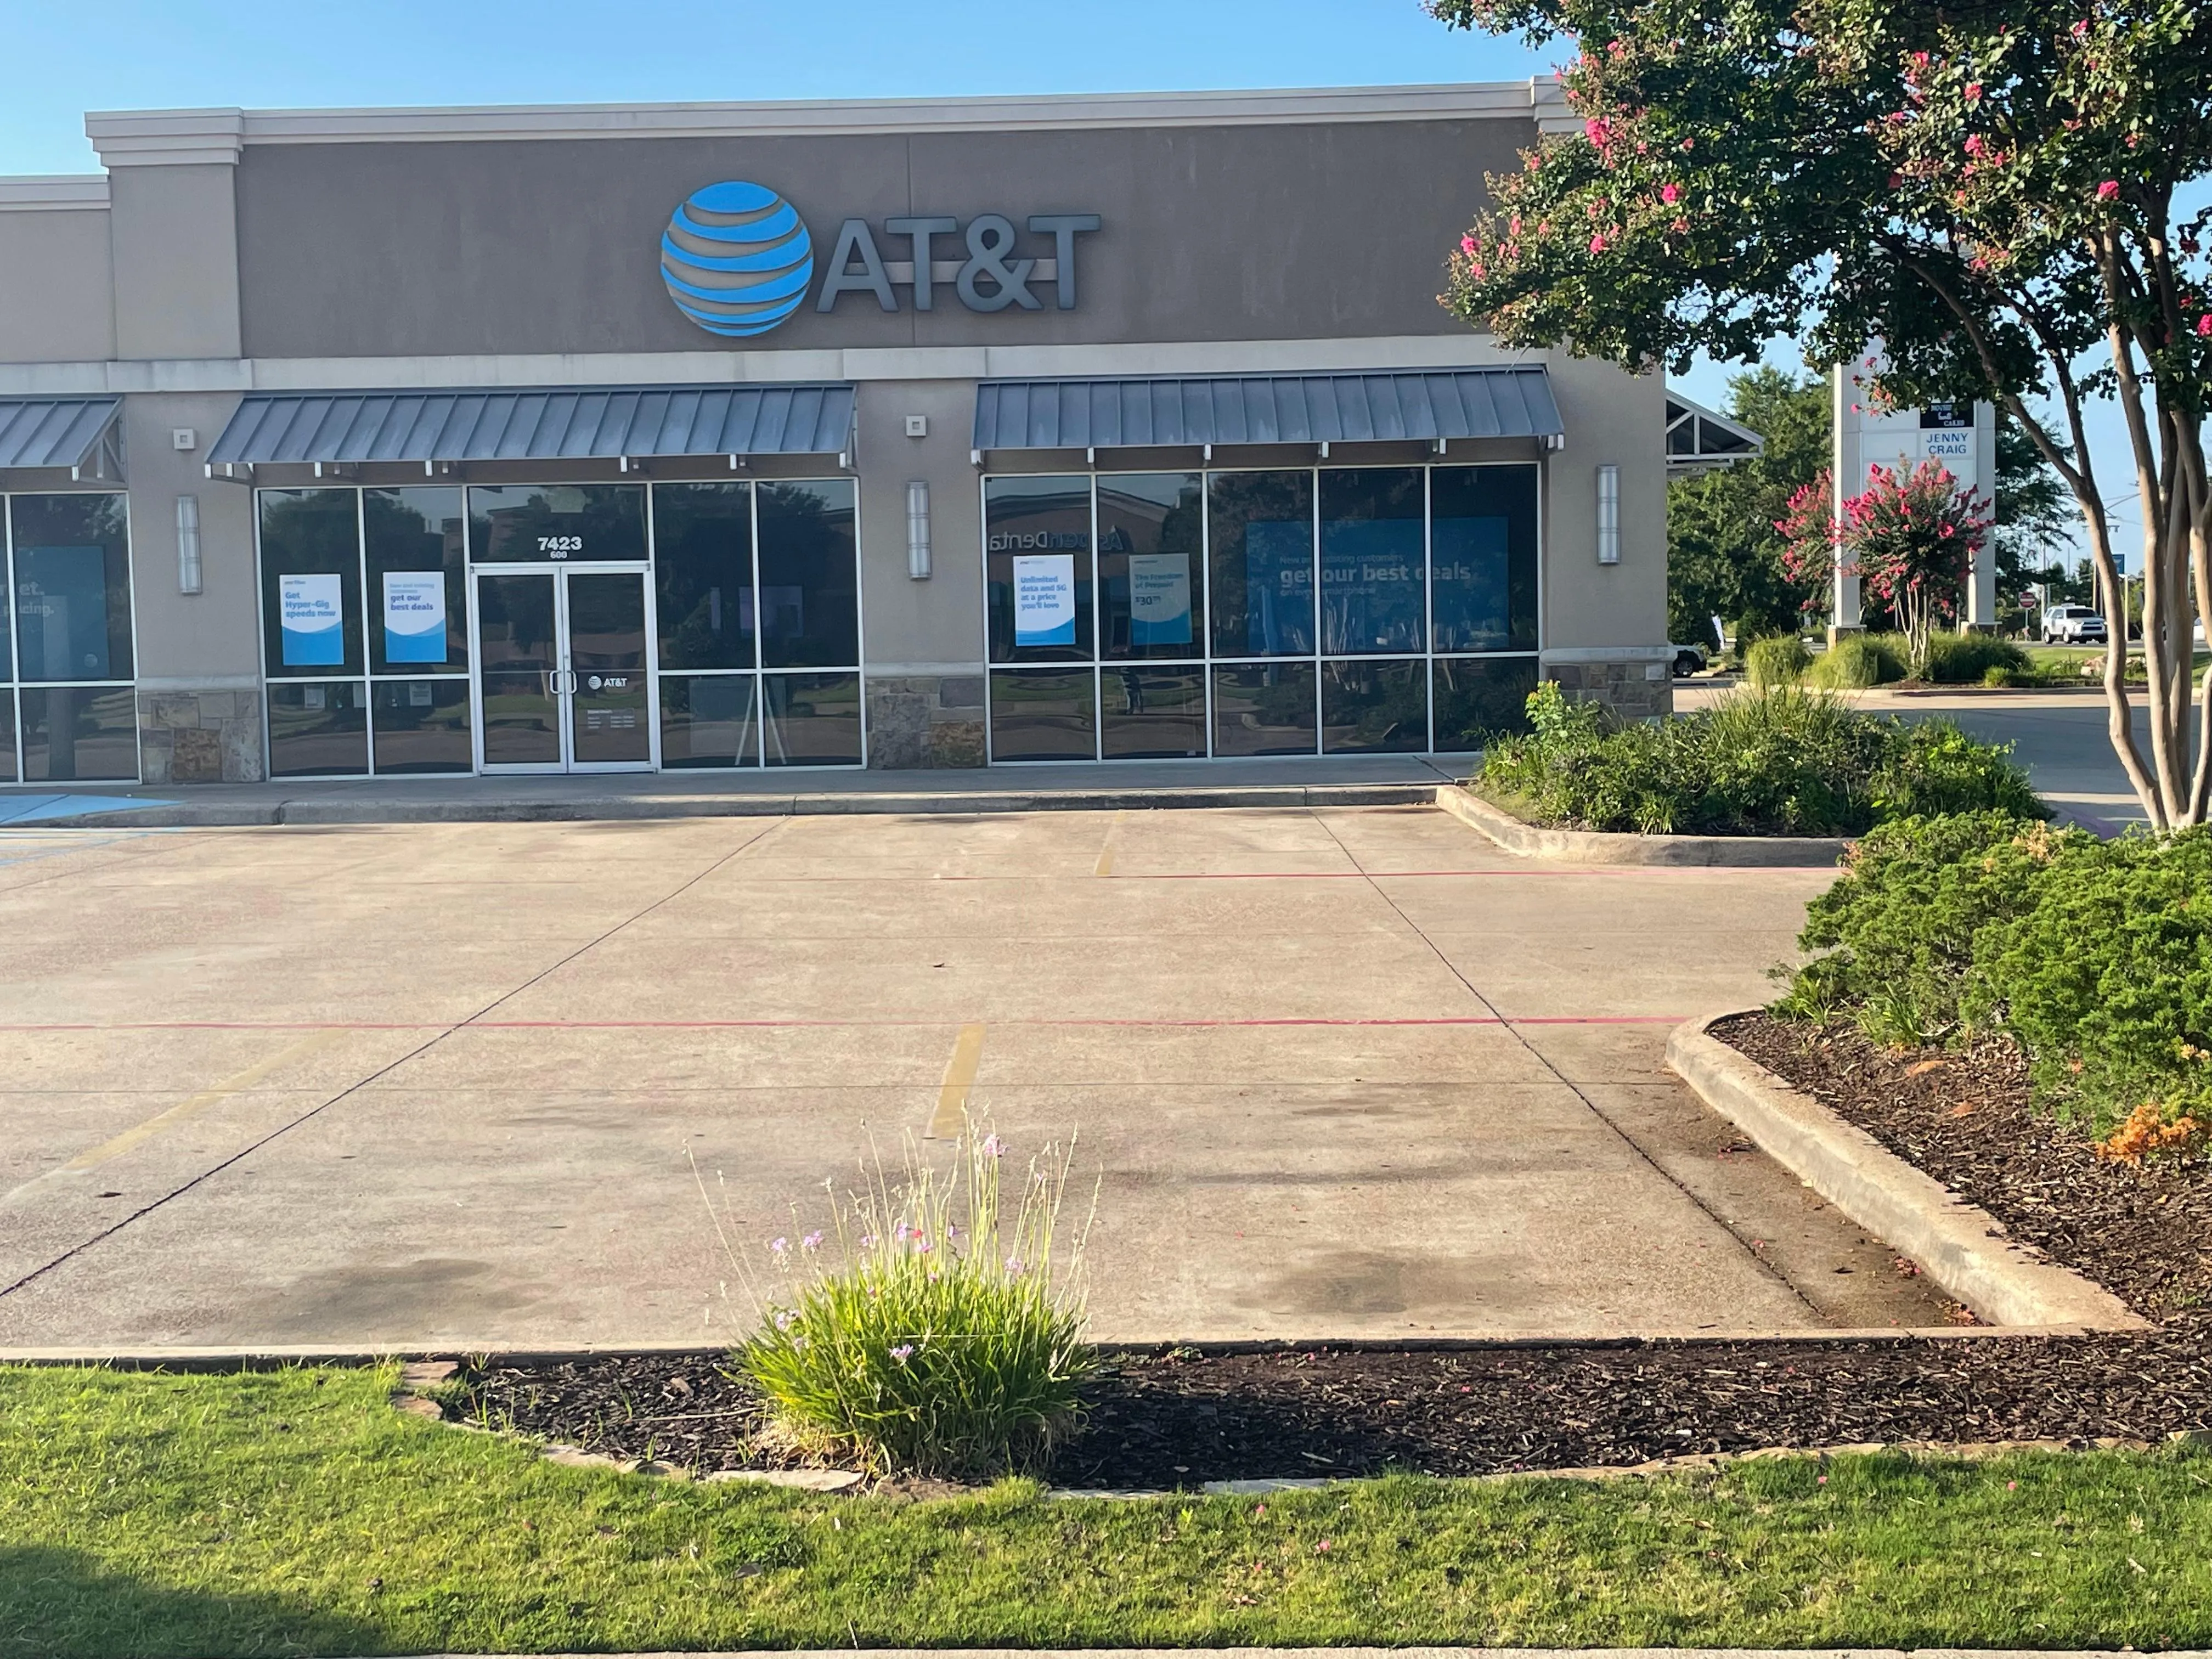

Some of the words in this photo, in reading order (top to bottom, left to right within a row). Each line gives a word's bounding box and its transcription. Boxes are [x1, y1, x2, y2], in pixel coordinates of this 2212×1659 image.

[816, 213, 1101, 313] AT&T
[1926, 432, 1968, 443] JENNY
[1928, 444, 1966, 454] CRAIG
[537, 536, 582, 551] 7423
[1020, 575, 1058, 584] Unlimited
[1280, 567, 1313, 588] get
[1322, 568, 1357, 582] our
[1363, 563, 1409, 581] best
[391, 594, 404, 603] get
[1037, 593, 1057, 602] price
[285, 600, 330, 610] Hyper-Gig
[411, 602, 433, 611] deals
[286, 609, 315, 619] speeds
[603, 677, 628, 687] AT&T
